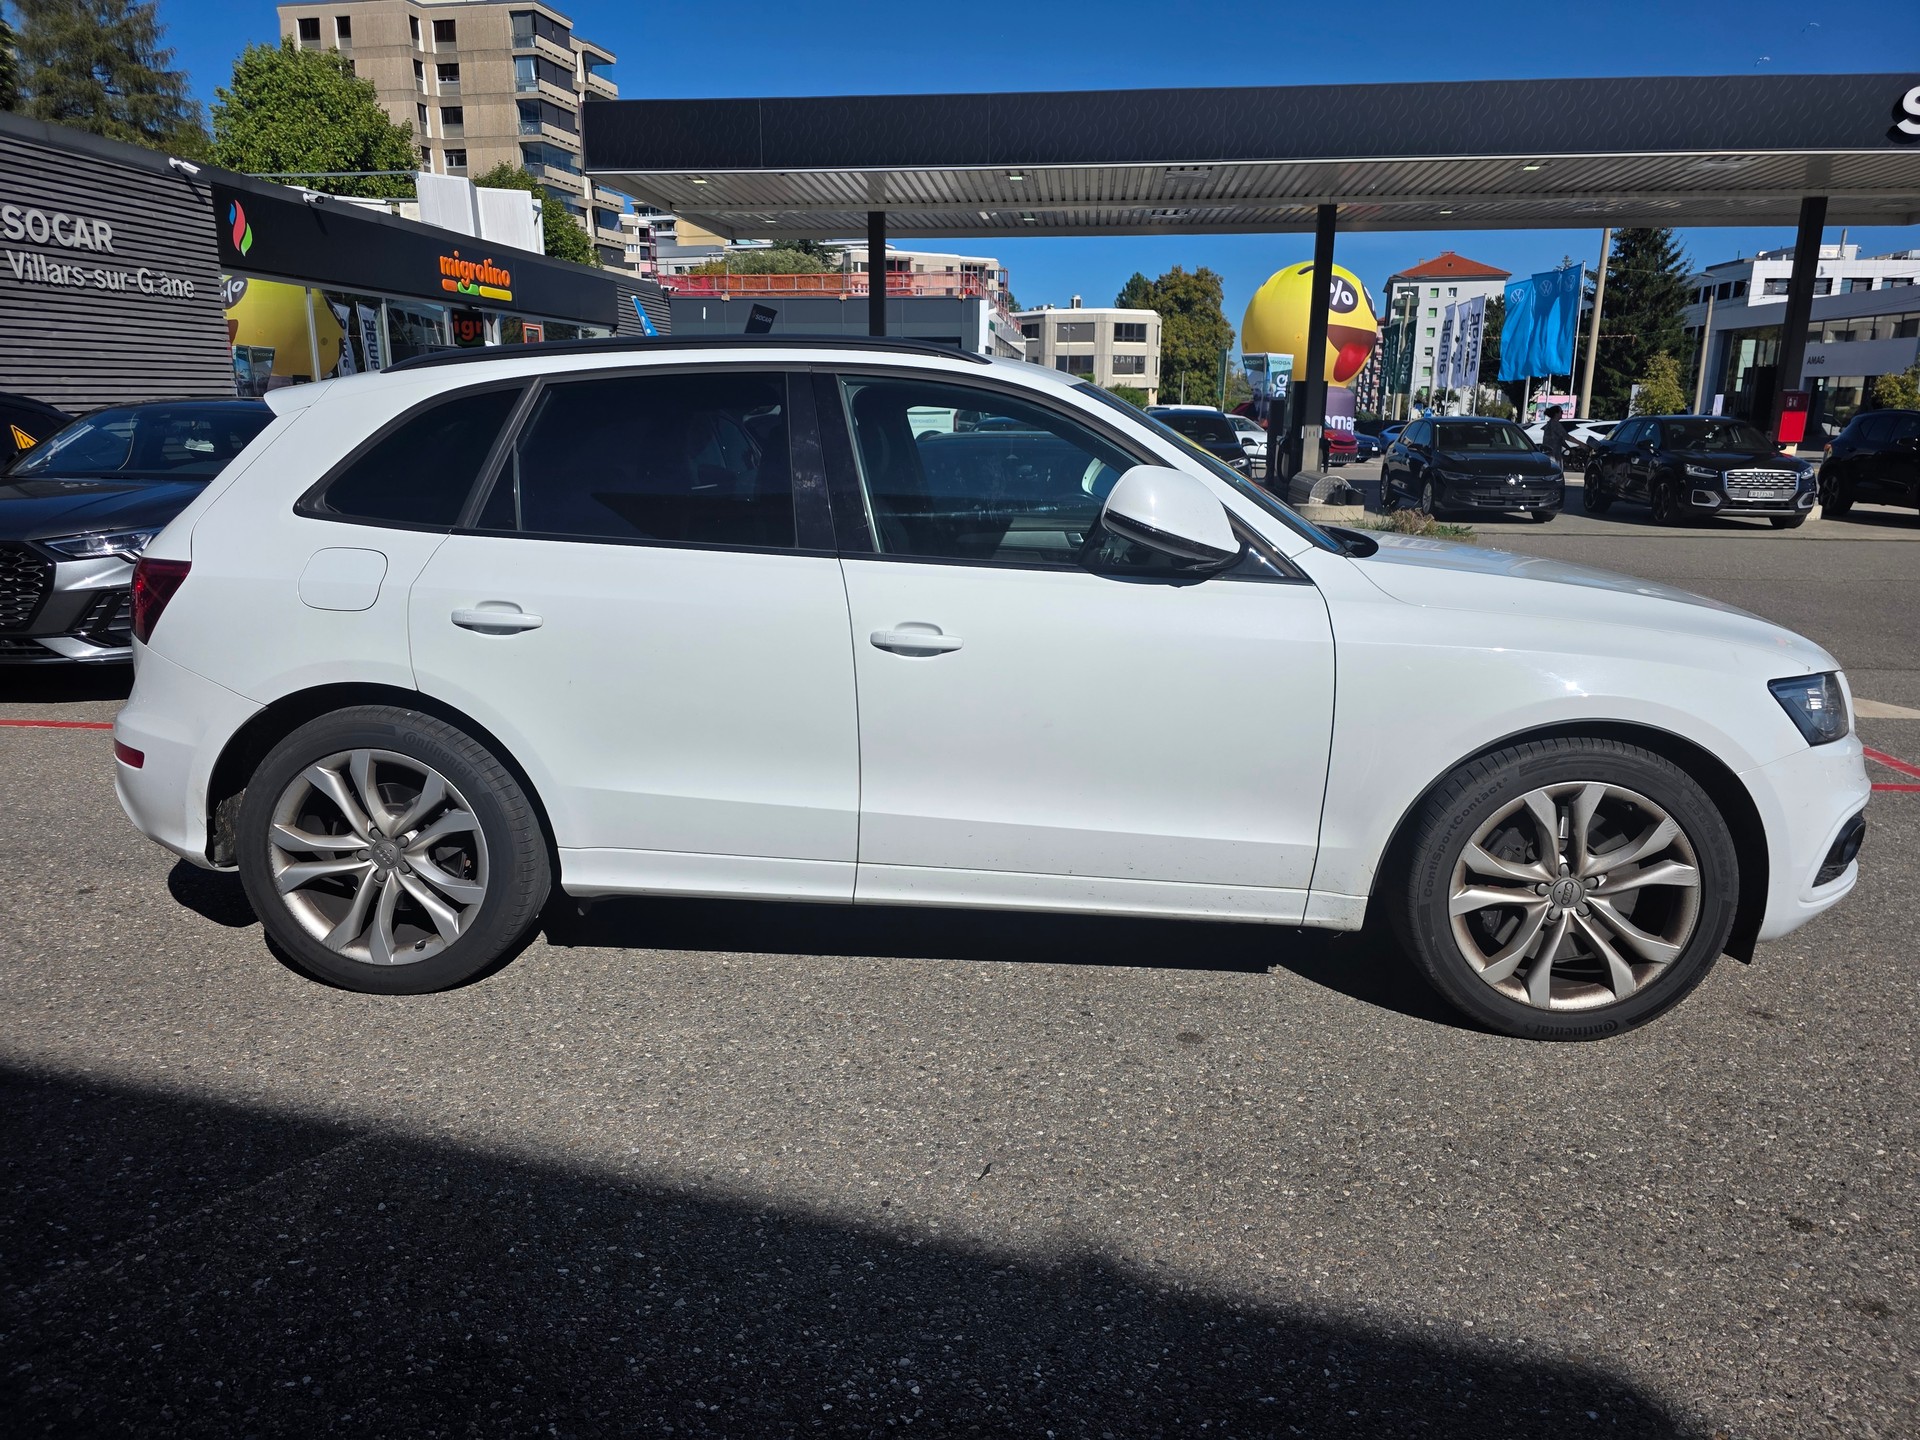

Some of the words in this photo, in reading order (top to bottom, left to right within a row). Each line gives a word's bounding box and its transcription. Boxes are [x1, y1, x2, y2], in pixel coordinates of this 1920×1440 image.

[1, 205, 115, 253] SOCAR
[5, 250, 195, 298] Villars-sur-Gâne
[439, 250, 511, 288] migrolino
[1806, 355, 1825, 365] AMAG
[403, 731, 473, 778] Continental
[1423, 781, 1504, 898] ContiSportContact
[1533, 1019, 1619, 1038] Continental
